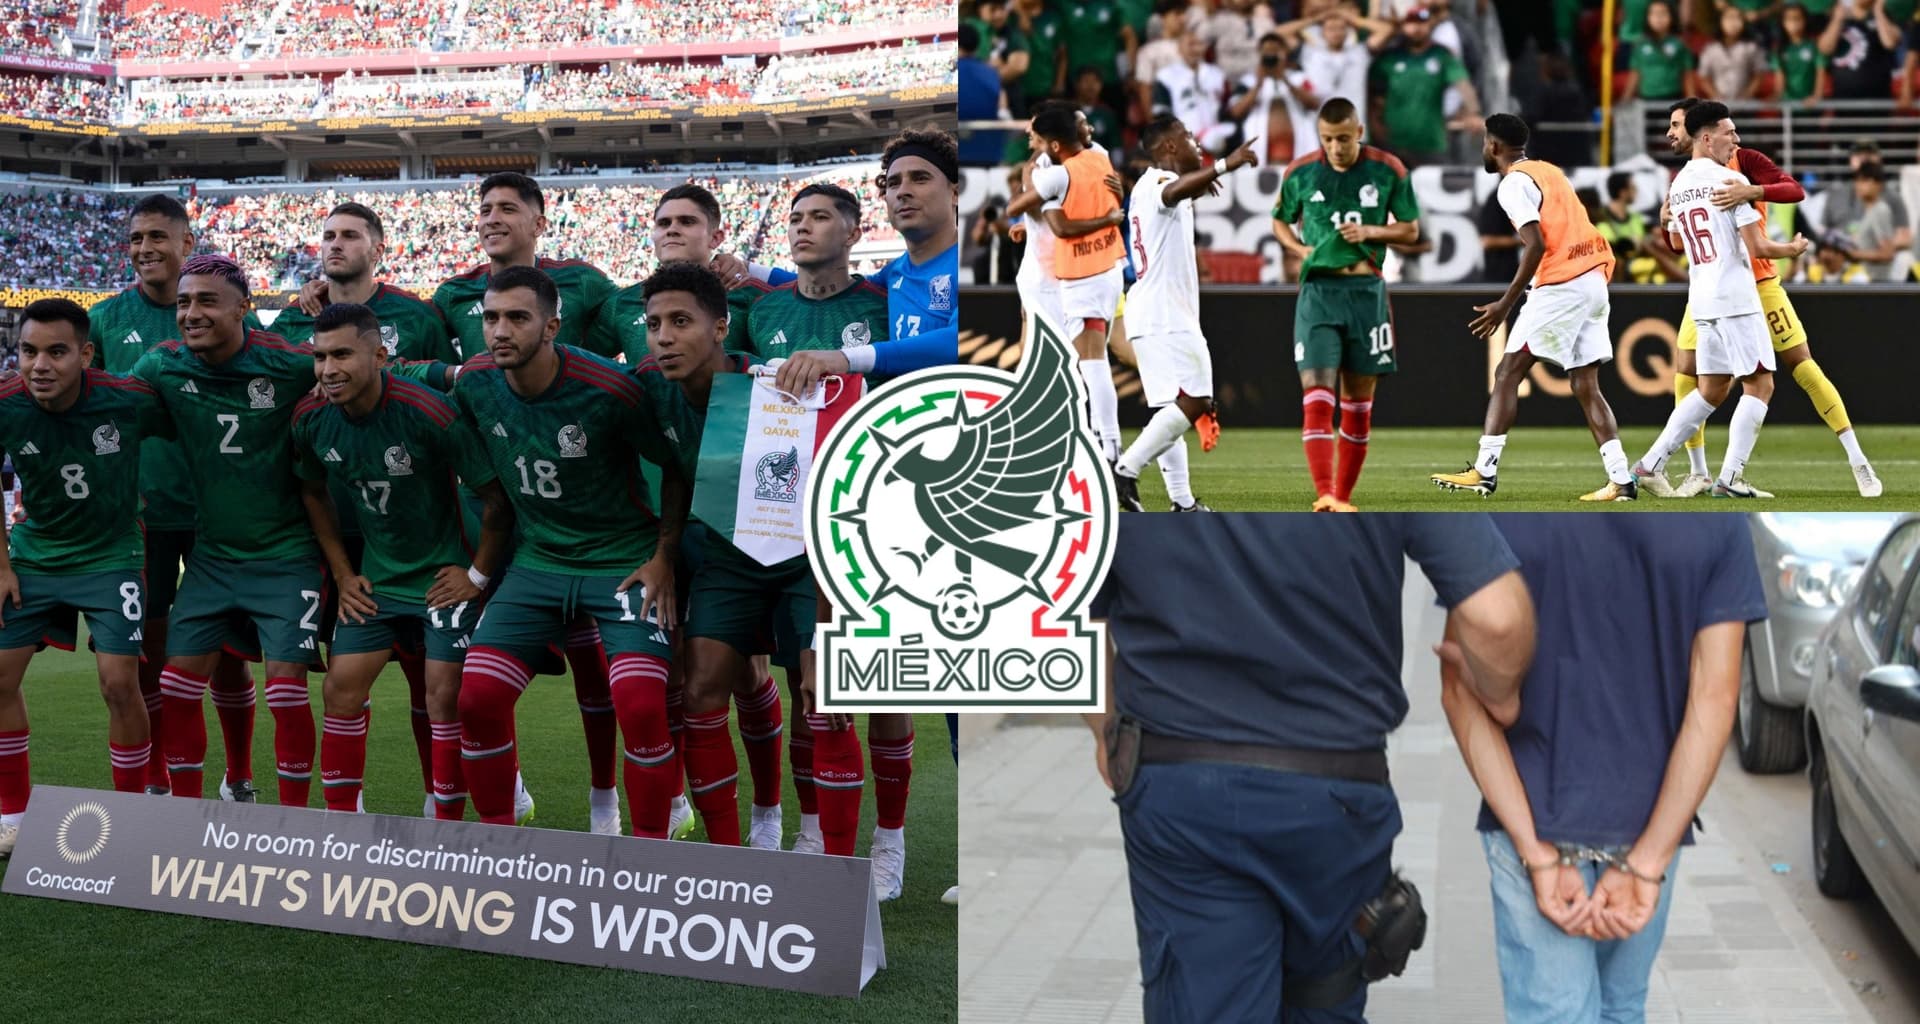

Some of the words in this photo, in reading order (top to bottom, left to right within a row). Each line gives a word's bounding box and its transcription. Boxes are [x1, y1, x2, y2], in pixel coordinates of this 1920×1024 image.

[26, 57, 45, 67] AND
[1073, 241, 1093, 258] THIS
[1678, 207, 1717, 266] 16
[1369, 322, 1393, 356] 10
[1767, 307, 1792, 335] 21
[762, 404, 807, 415] MEXICO
[216, 414, 243, 454] 2
[763, 427, 800, 438] QATAR
[60, 463, 90, 499] 8
[514, 455, 563, 499] 18
[355, 480, 392, 515] 17
[119, 581, 142, 621] 8
[299, 590, 320, 631] 2
[26, 866, 116, 896] Concacaf
[202, 821, 240, 851] No
[244, 831, 315, 858] room
[321, 834, 361, 861] for
[365, 838, 572, 885] discrimination
[579, 858, 606, 889] in
[613, 870, 667, 895] our
[674, 876, 774, 906] game
[151, 854, 312, 912] WHAT'S
[322, 872, 515, 936] WRONG
[530, 895, 577, 944] IS
[590, 901, 817, 974] WRONG
